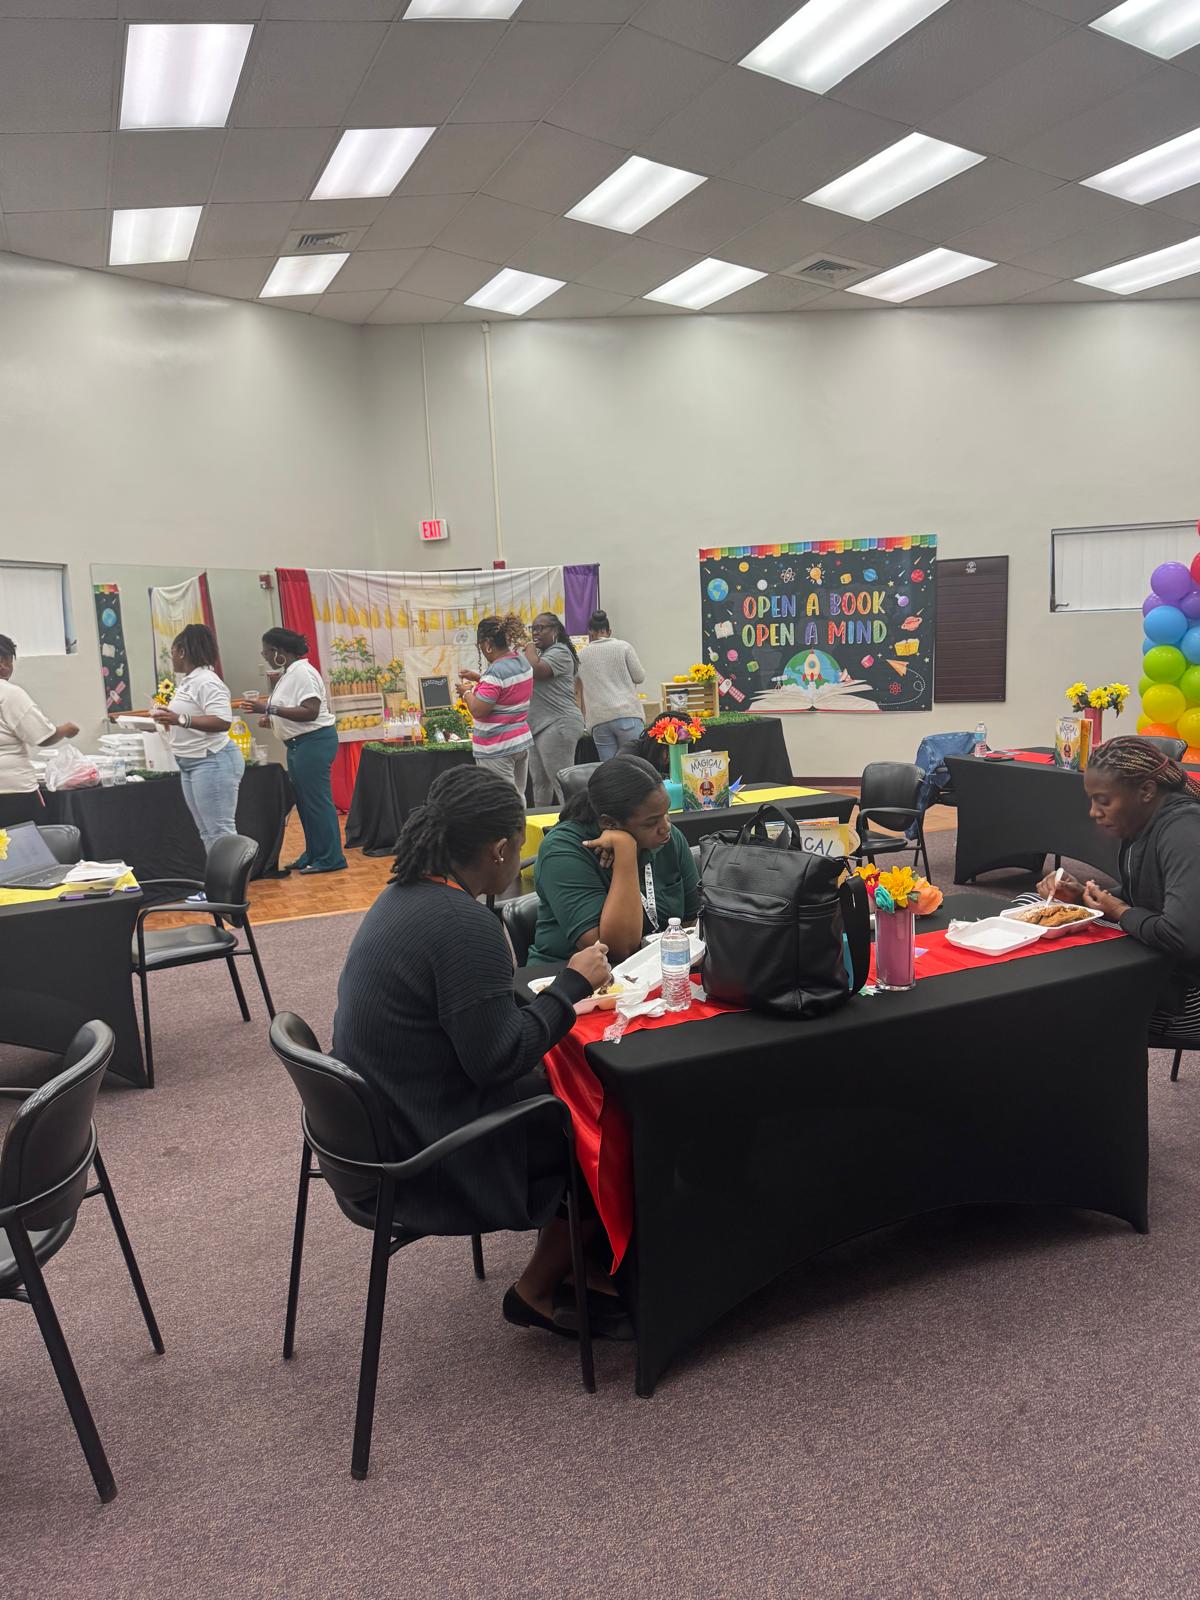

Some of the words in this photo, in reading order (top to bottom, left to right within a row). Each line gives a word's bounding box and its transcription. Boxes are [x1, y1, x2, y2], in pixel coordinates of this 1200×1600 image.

[421, 520, 441, 539] EXIT
[743, 595, 796, 619] OPEN
[806, 592, 820, 617] A
[830, 591, 886, 616] BOOK
[742, 622, 795, 647] OPEN
[804, 621, 818, 645] A
[827, 619, 887, 645] MIND
[690, 758, 722, 773] MAGICAL
